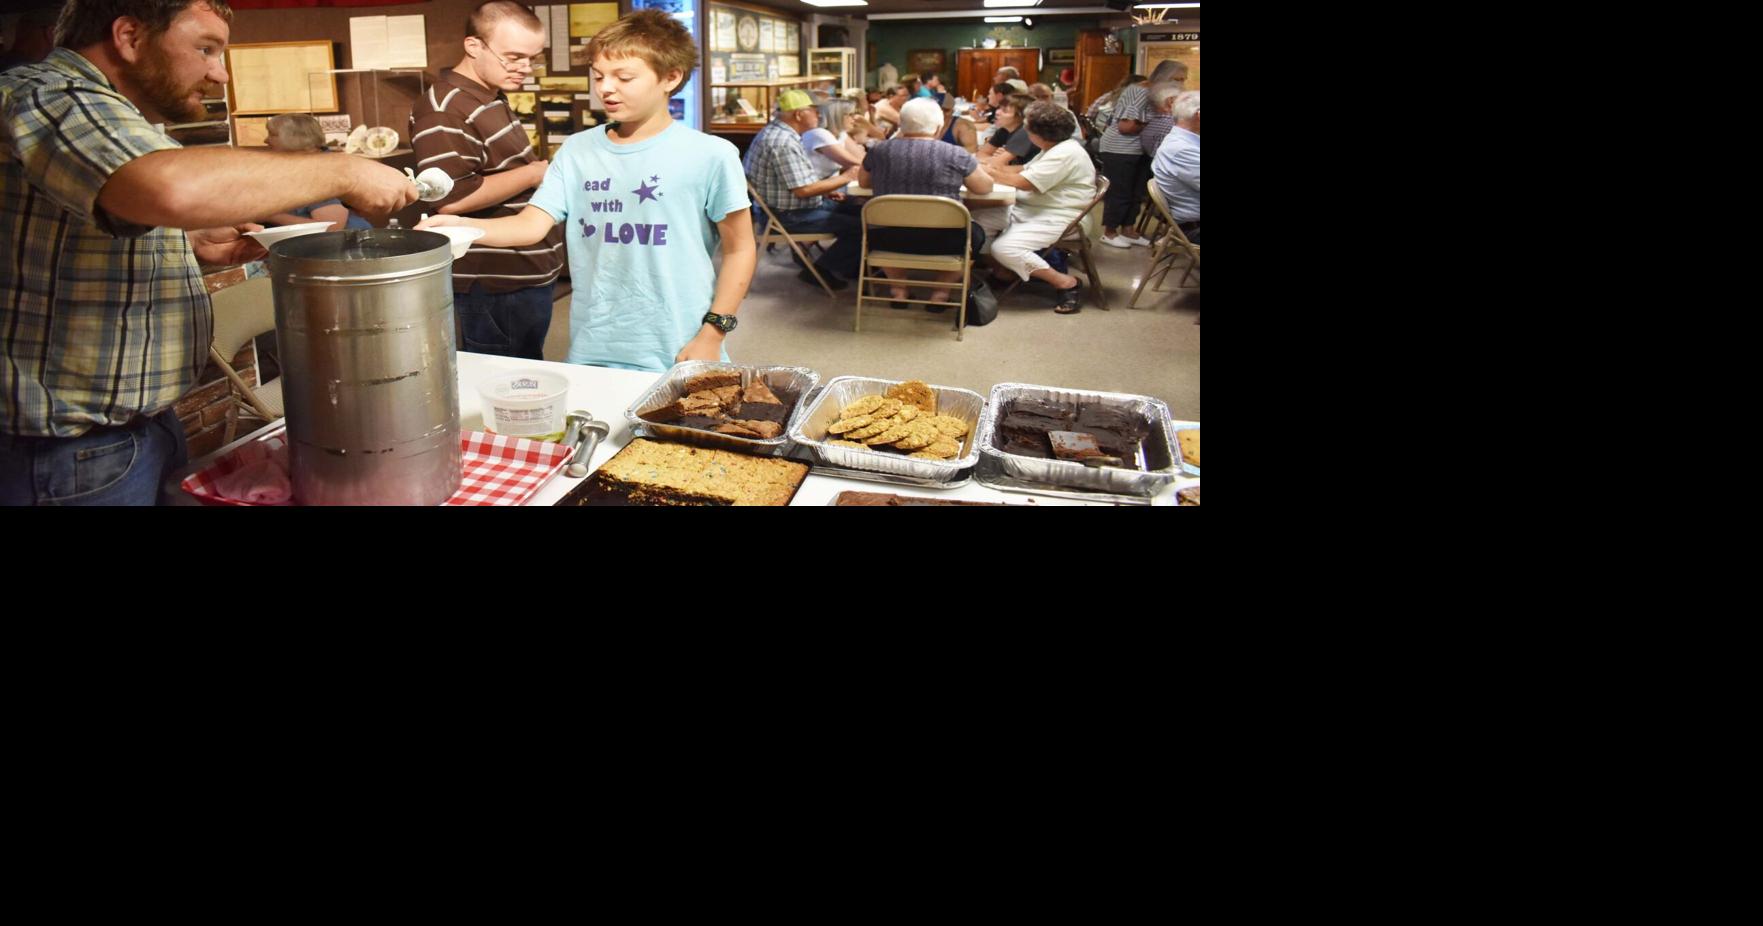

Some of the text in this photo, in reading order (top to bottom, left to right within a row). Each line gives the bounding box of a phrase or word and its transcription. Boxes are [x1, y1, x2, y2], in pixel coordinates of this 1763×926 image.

[1171, 33, 1199, 41] 1879
[583, 177, 611, 191] ead
[590, 199, 623, 213] with
[604, 222, 669, 246] LOVE
